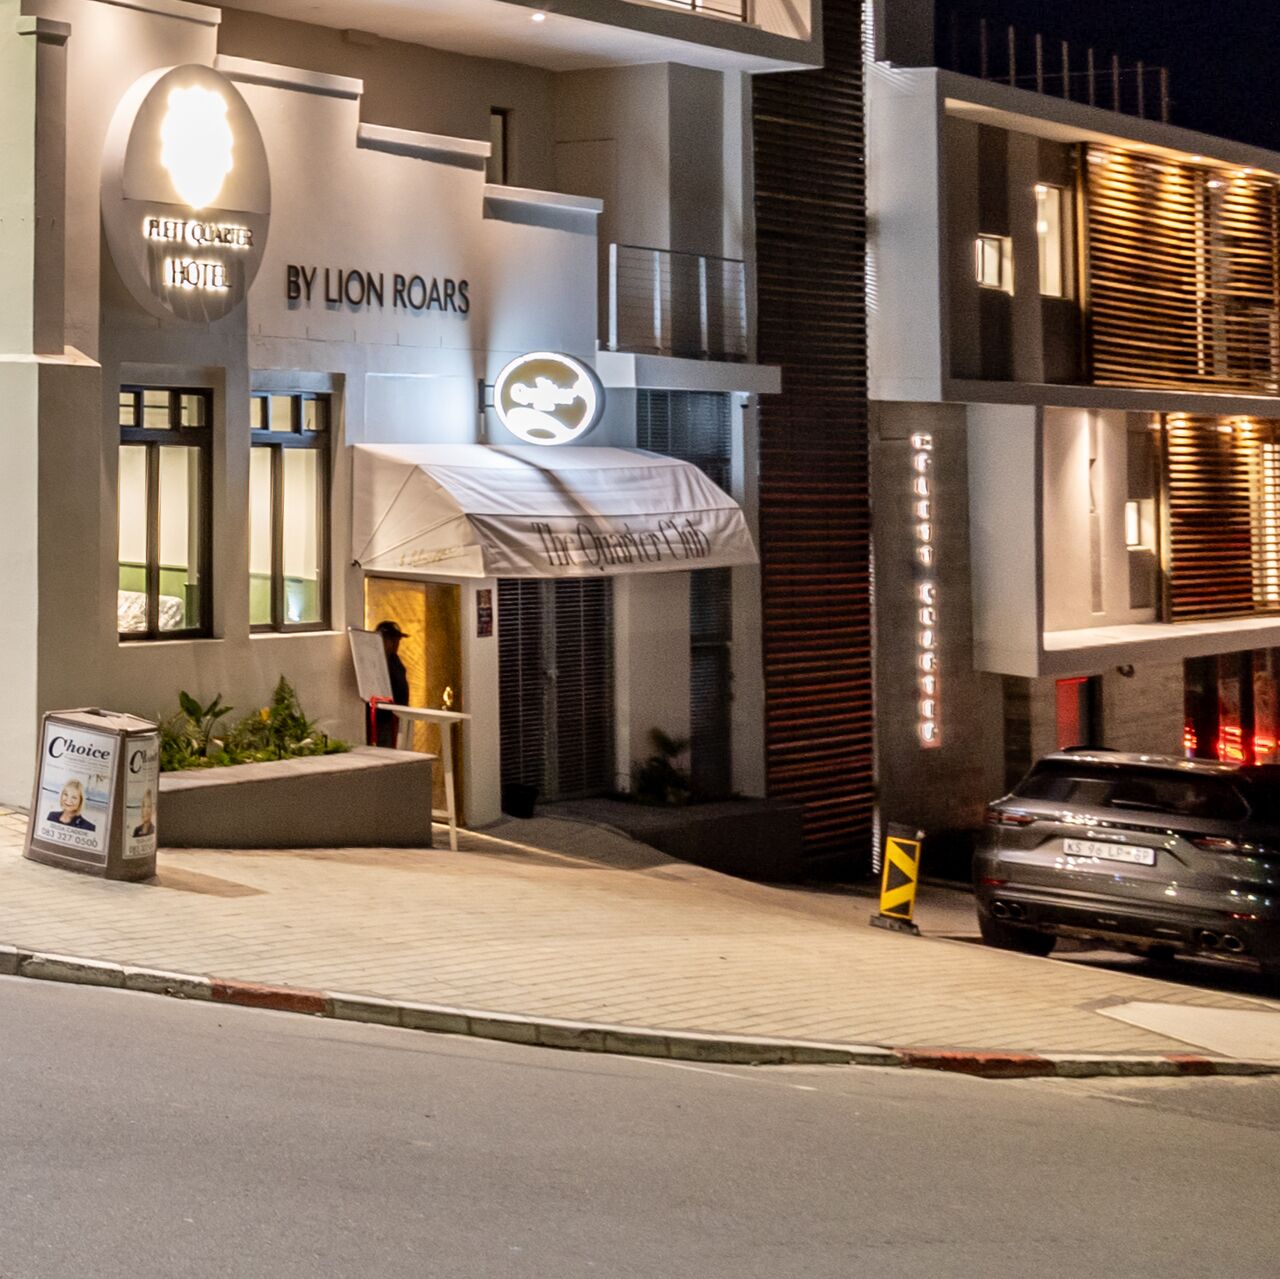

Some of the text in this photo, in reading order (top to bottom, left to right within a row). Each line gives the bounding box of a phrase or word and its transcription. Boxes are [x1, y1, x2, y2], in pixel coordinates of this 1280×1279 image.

[171, 260, 232, 288] HOTEL
[286, 264, 470, 314] BY LION ROARS
[531, 518, 711, 572] The Quarter Club
[48, 736, 111, 760] Choice
